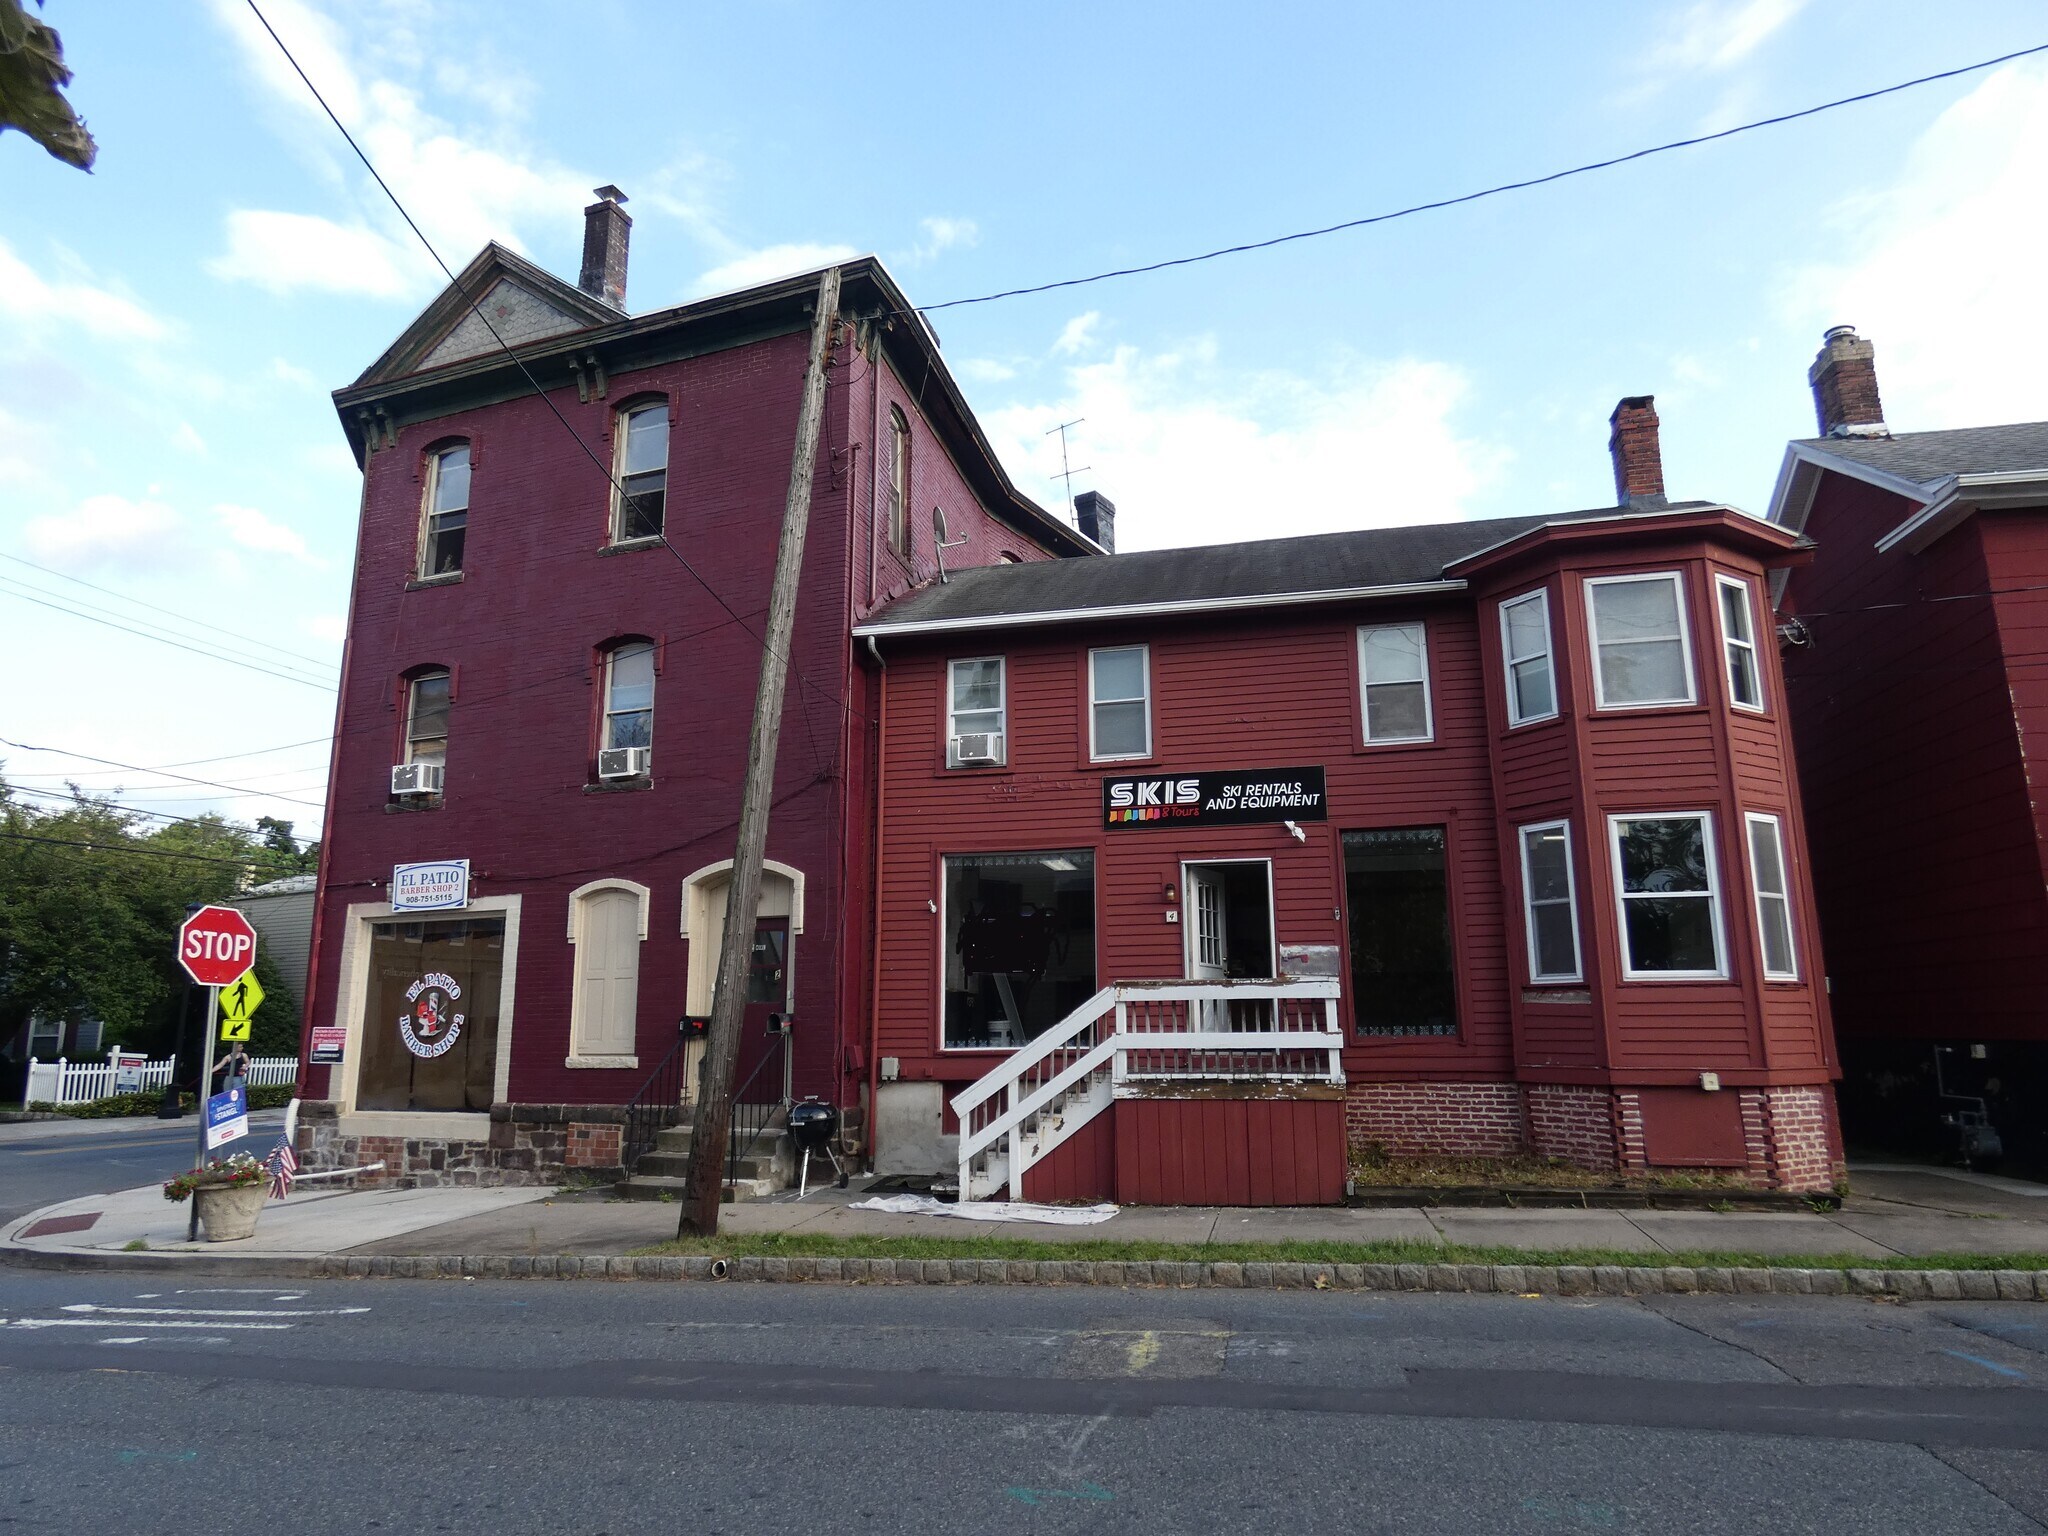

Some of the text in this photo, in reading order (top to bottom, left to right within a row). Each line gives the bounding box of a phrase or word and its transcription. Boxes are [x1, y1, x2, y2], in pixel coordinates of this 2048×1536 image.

[1110, 780, 1200, 806] SKIS
[1222, 782, 1302, 797] SKI RENTALS
[1205, 794, 1320, 810] AND EQUIPMENT
[1171, 807, 1200, 817] Tours
[401, 870, 459, 886] EL PATIO
[400, 886, 430, 895] BARBER
[432, 884, 453, 893] SHOP
[406, 894, 453, 903] 908-751-5115
[185, 929, 251, 962] STOP
[406, 973, 461, 1002] EL PATIO
[400, 1013, 465, 1057] BARBER SHOP 2
